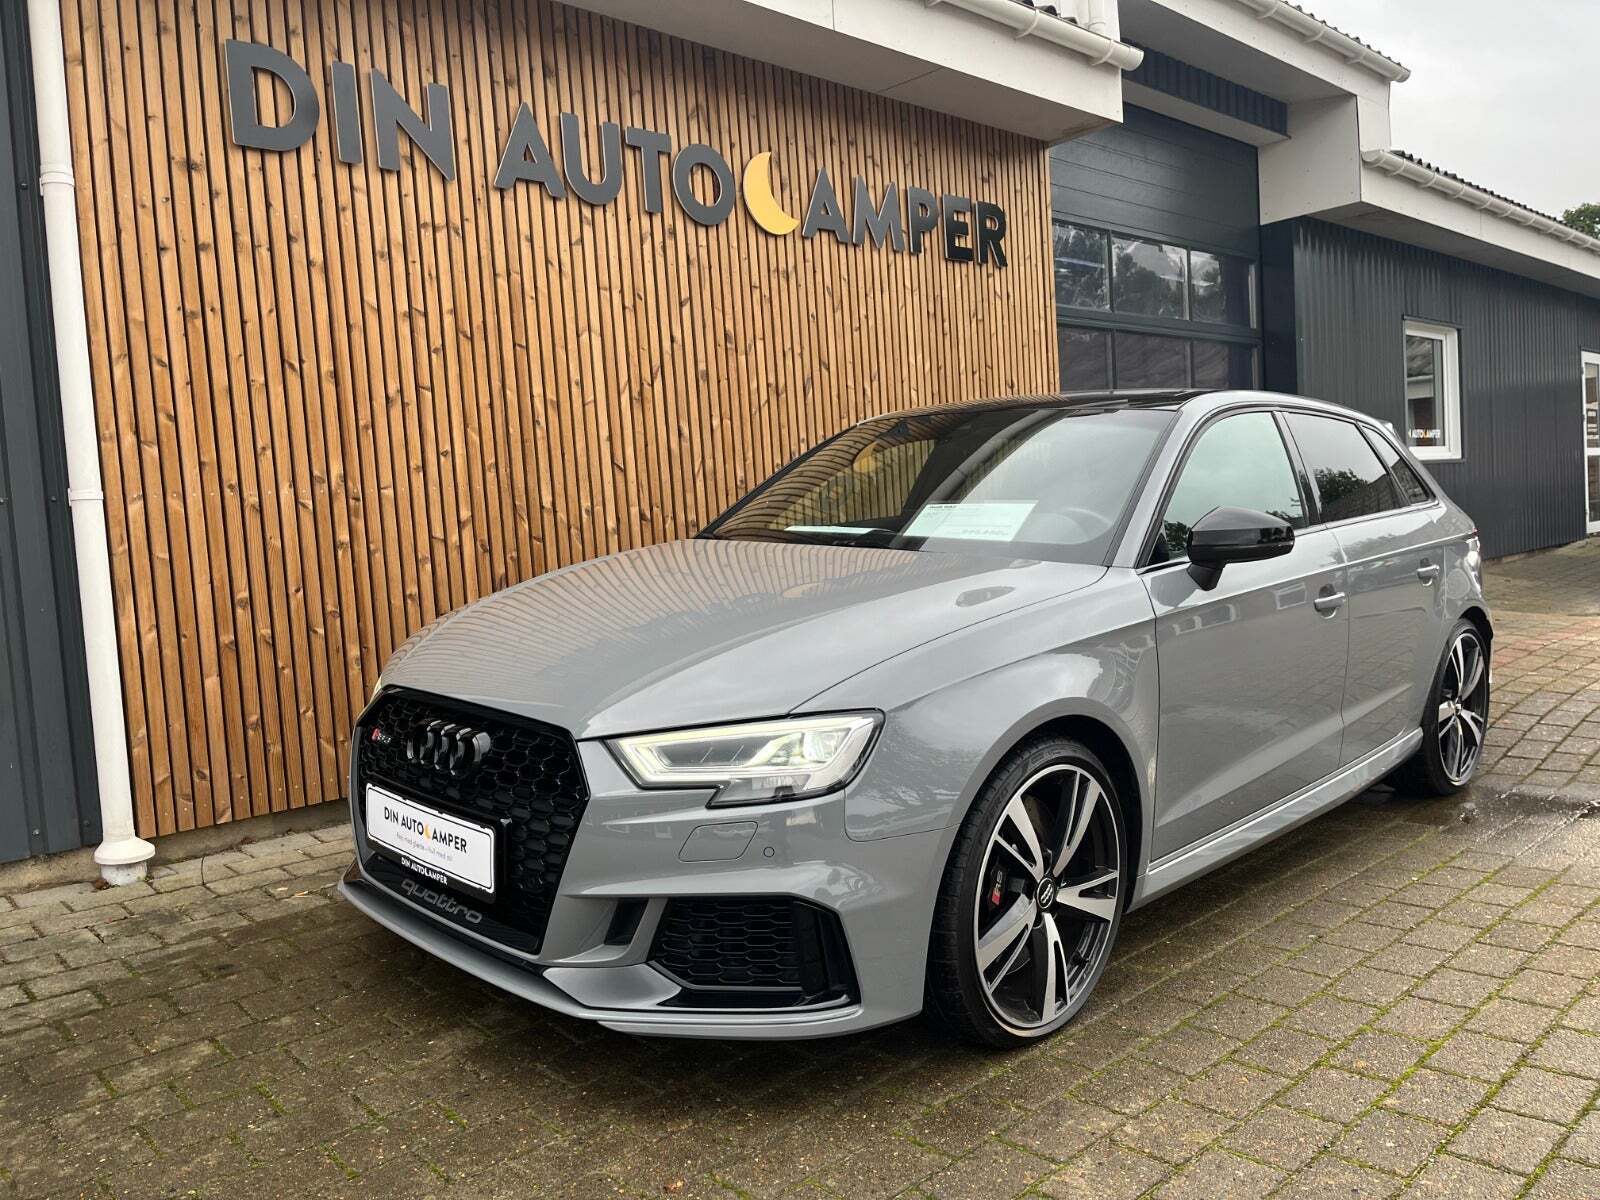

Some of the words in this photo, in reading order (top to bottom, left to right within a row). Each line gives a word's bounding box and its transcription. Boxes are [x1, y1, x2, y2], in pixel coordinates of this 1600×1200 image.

[224, 38, 455, 182] DIN
[384, 806, 399, 824] DIN
[401, 857, 410, 867] DIN
[401, 879, 483, 924] quattro
